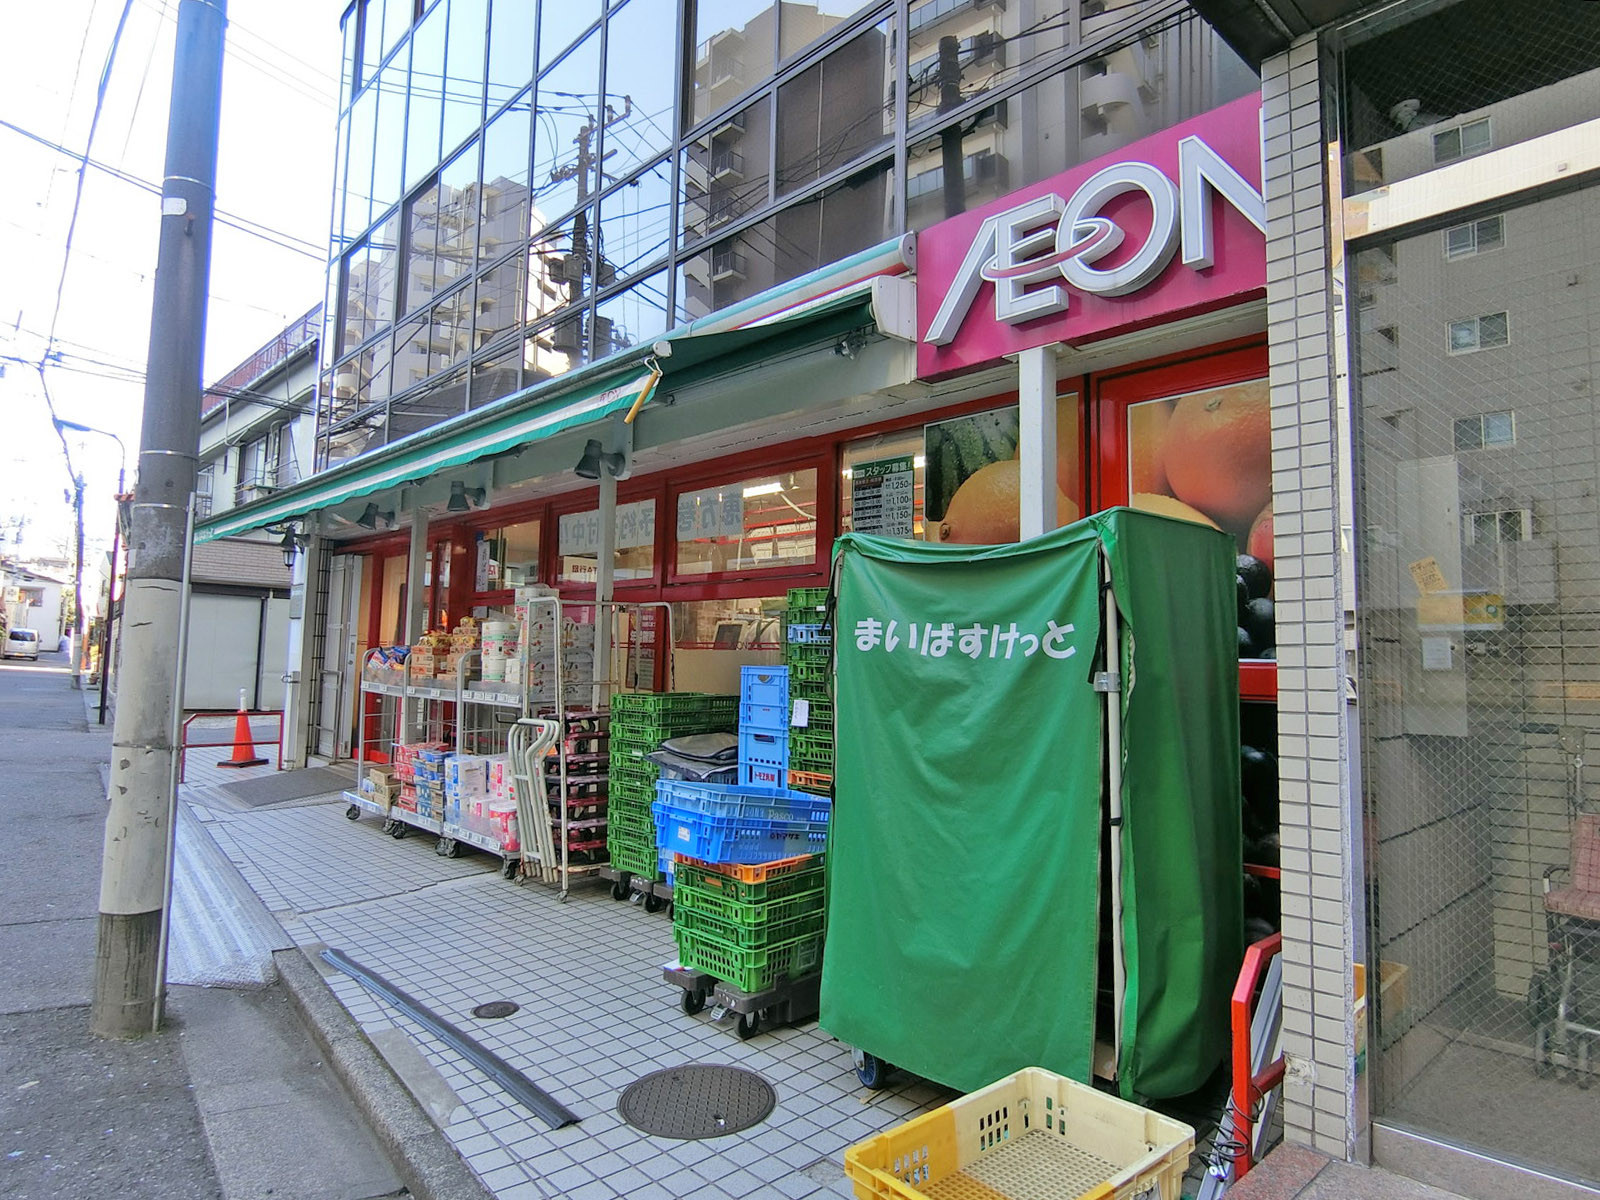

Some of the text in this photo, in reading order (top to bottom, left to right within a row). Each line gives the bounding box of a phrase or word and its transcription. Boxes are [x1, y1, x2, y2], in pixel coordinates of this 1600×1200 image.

[855, 617, 1076, 660] まいばすけっと
